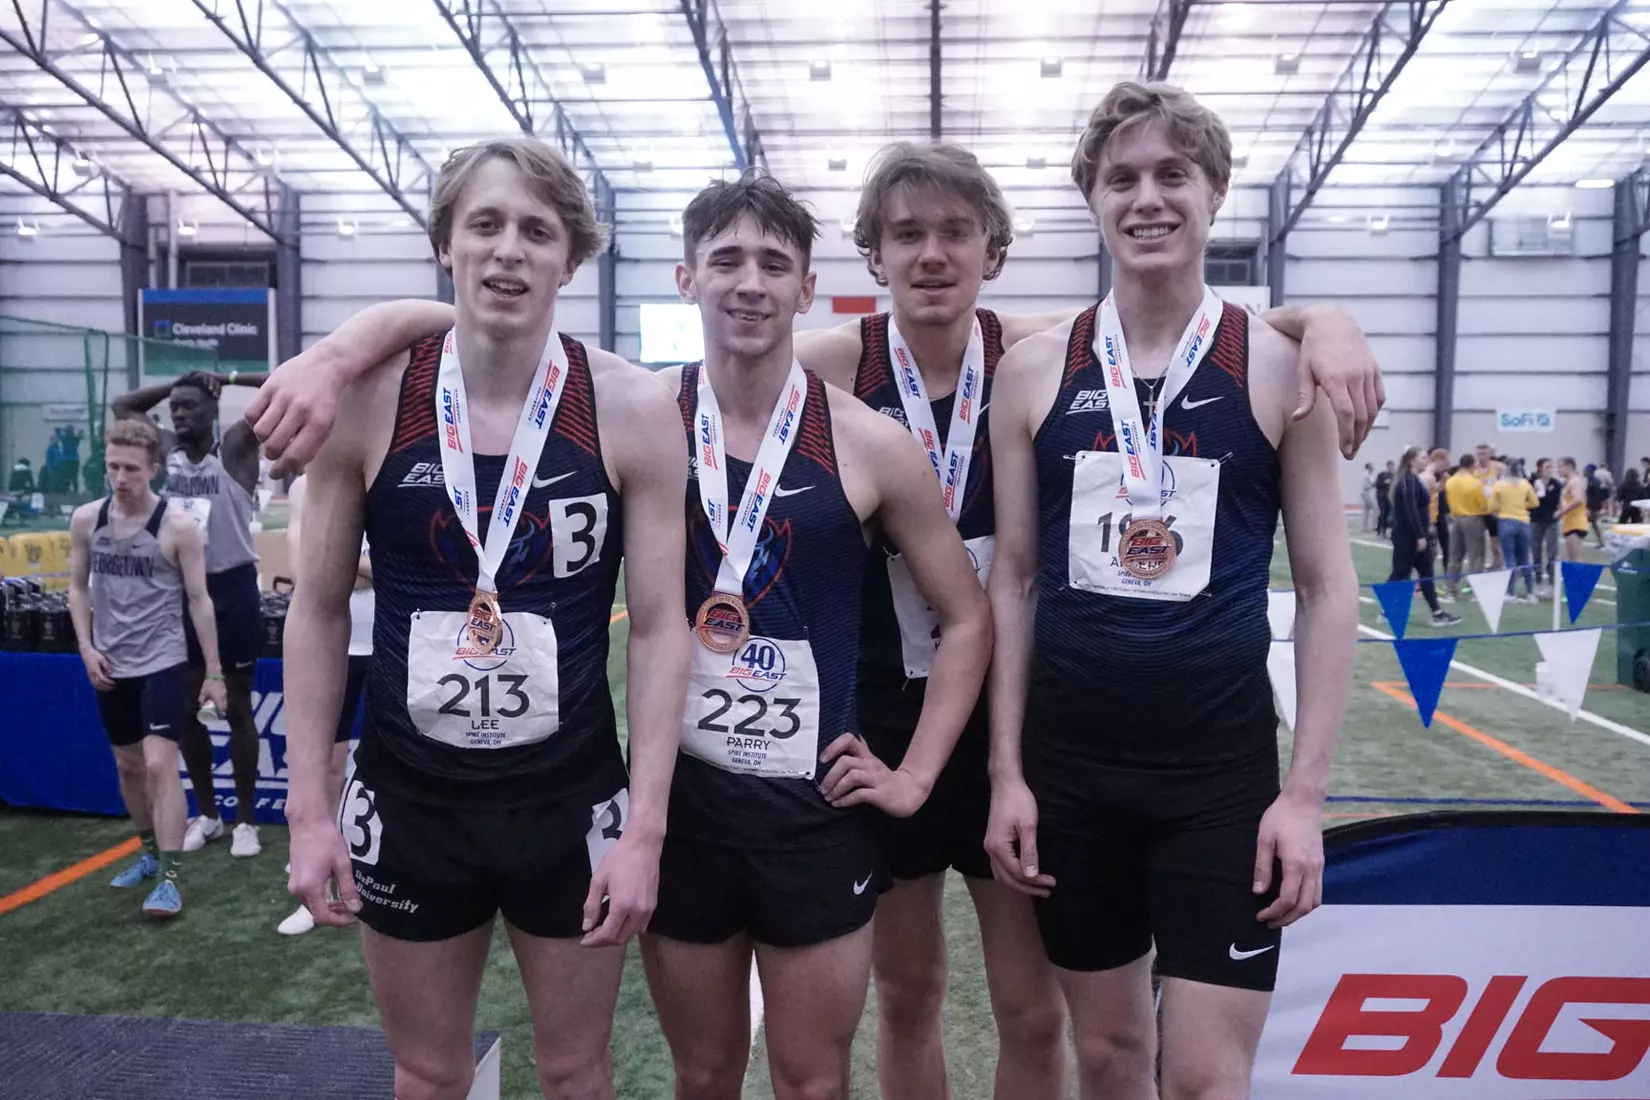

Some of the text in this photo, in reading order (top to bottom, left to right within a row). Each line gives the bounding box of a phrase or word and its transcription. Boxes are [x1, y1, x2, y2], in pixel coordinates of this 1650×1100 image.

[172, 322, 258, 335] Cleveland Clinic
[1201, 319, 1212, 338] BIG
[1105, 335, 1117, 366] EAST
[1186, 337, 1203, 367] EAST
[898, 347, 910, 368] BIG
[904, 366, 921, 399] EAST
[1109, 366, 1121, 388] BIG
[535, 365, 561, 430] BIG EAST
[959, 365, 975, 421] BIG EAST
[1070, 400, 1110, 409] EAS
[1076, 389, 1108, 400] BIG
[443, 387, 458, 450] BIG EAST
[778, 390, 800, 445] BIG EAST
[1501, 413, 1534, 427] SoFi
[701, 413, 713, 467] BIG EAST
[924, 428, 936, 451] BIG
[1120, 419, 1140, 479] BIG EAST
[402, 472, 445, 484] EAS
[943, 450, 959, 508] BIG EAST
[503, 462, 528, 528] BIG EAST
[747, 472, 772, 533] BIG EAST
[564, 501, 597, 573] 3
[1131, 537, 1163, 546] BIG
[1127, 546, 1172, 555] EAST
[471, 617, 497, 632] EAST
[472, 608, 492, 621] BIG
[704, 617, 745, 631] EAST
[710, 608, 742, 622] BIG
[491, 648, 517, 656] AST
[741, 643, 775, 671] 40
[730, 667, 787, 680] BIG EAST
[437, 673, 530, 718] 213
[471, 720, 500, 730] LEE
[697, 688, 803, 740] 223
[727, 736, 771, 750] PARRY
[350, 788, 376, 857] 3
[355, 869, 396, 894] DePaul
[356, 882, 420, 913] University
[1290, 973, 1650, 1081] BIG
